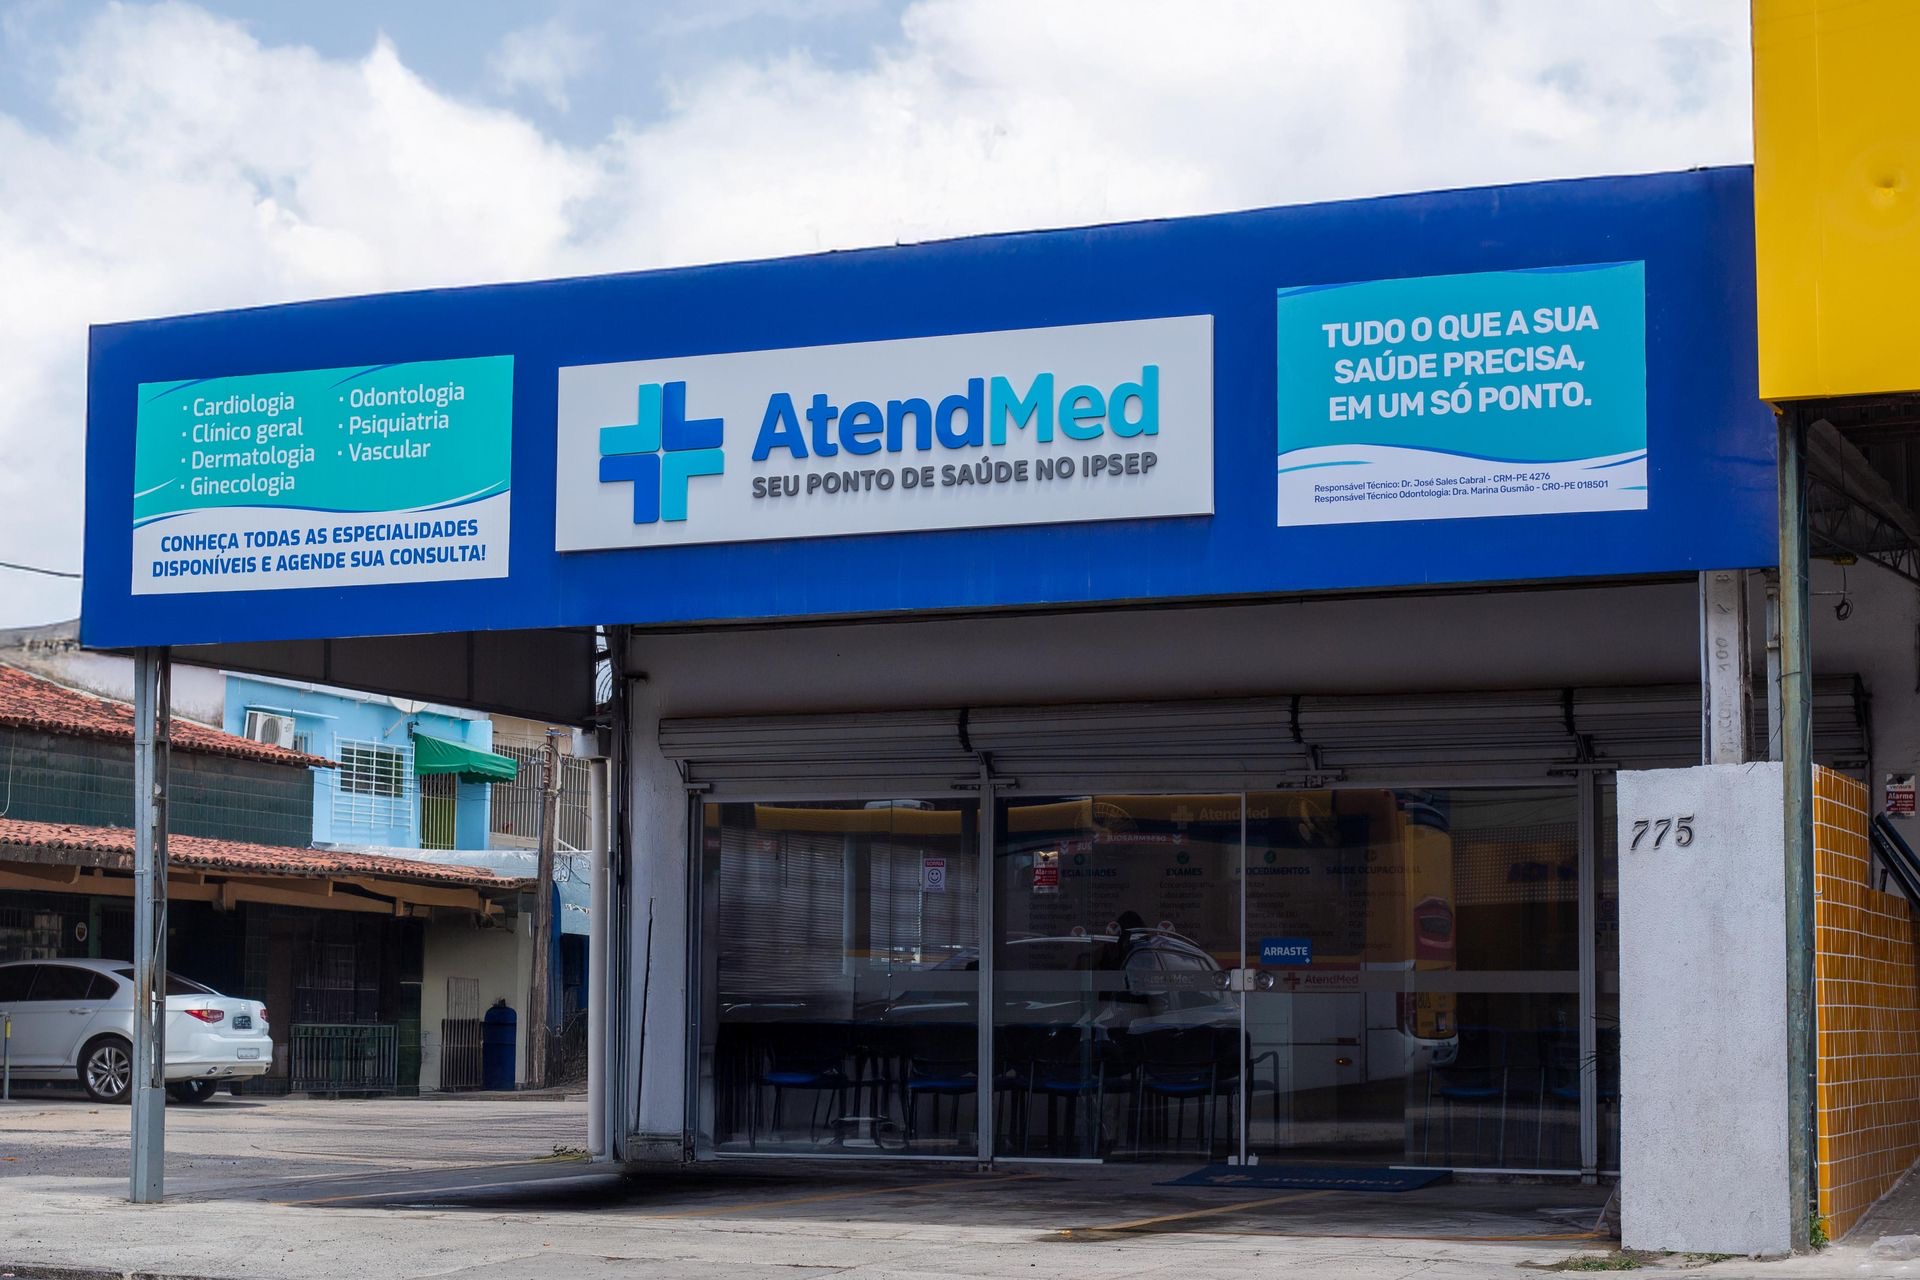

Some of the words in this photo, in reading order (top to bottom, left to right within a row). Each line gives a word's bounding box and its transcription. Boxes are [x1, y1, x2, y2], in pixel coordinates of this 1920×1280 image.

[1322, 318, 1406, 348] TUDO
[1411, 317, 1434, 341] O
[1438, 312, 1502, 342] QUE
[1506, 310, 1530, 336] A
[1533, 305, 1600, 334] SUA
[1334, 350, 1437, 384] SAÚDE
[1443, 344, 1585, 377] PRECISA,
[193, 391, 296, 417] Cardiologia
[349, 381, 465, 409] Odontologia
[1329, 395, 1372, 422] EM
[1378, 391, 1424, 419] UM
[1430, 382, 1473, 415] SÓ
[1478, 381, 1592, 412] PONTO.
[348, 410, 449, 437] Psiquiatria
[751, 364, 1160, 461] AtendMed
[192, 421, 251, 443] Clínico
[256, 417, 304, 444] geral
[191, 445, 316, 471] Dermatologia
[348, 438, 431, 463] Vascular
[190, 473, 296, 497] Ginecologia
[751, 473, 800, 498] SEU
[806, 468, 895, 495] PONTO
[901, 464, 936, 489] DE
[941, 455, 1029, 486] SAÚDE
[1036, 455, 1075, 481] NO
[1082, 451, 1158, 477] IPSEP
[1314, 482, 1366, 493] Responsável
[1366, 480, 1400, 490] Técnico:
[1401, 480, 1413, 488] Dr.
[1414, 478, 1434, 487] José
[1435, 477, 1457, 486] Sales
[1459, 475, 1486, 484] Cabral
[1493, 473, 1528, 483] CRM-PE
[1529, 472, 1551, 480] 4276
[1314, 492, 1366, 504] Responsável
[1366, 491, 1398, 500] Técnico
[1399, 488, 1451, 499] Odontologia:
[1452, 487, 1469, 496] Dra.
[1471, 485, 1499, 495] Marina
[1500, 483, 1535, 493] Gusmão
[1542, 481, 1576, 491] CRO-PE
[1577, 480, 1609, 490] 018501
[160, 530, 240, 555] CONHEÇA
[243, 527, 301, 549] TODAS
[305, 526, 328, 545] AS
[332, 519, 478, 544] ESPECIALIDADES
[152, 553, 257, 578] DISPONÍVEIS
[261, 555, 272, 572] E
[276, 551, 346, 571] AGENDE
[350, 549, 385, 567] SUA
[389, 544, 487, 566] CONSULTA!
[1200, 806, 1270, 821] Atended
[1629, 814, 1695, 852] 775
[1166, 867, 1203, 877] EXAMES
[1235, 866, 1311, 876] POCEDIMENTOS
[1264, 946, 1308, 957] ARRASTE
[1304, 973, 1359, 985] AtendMed
